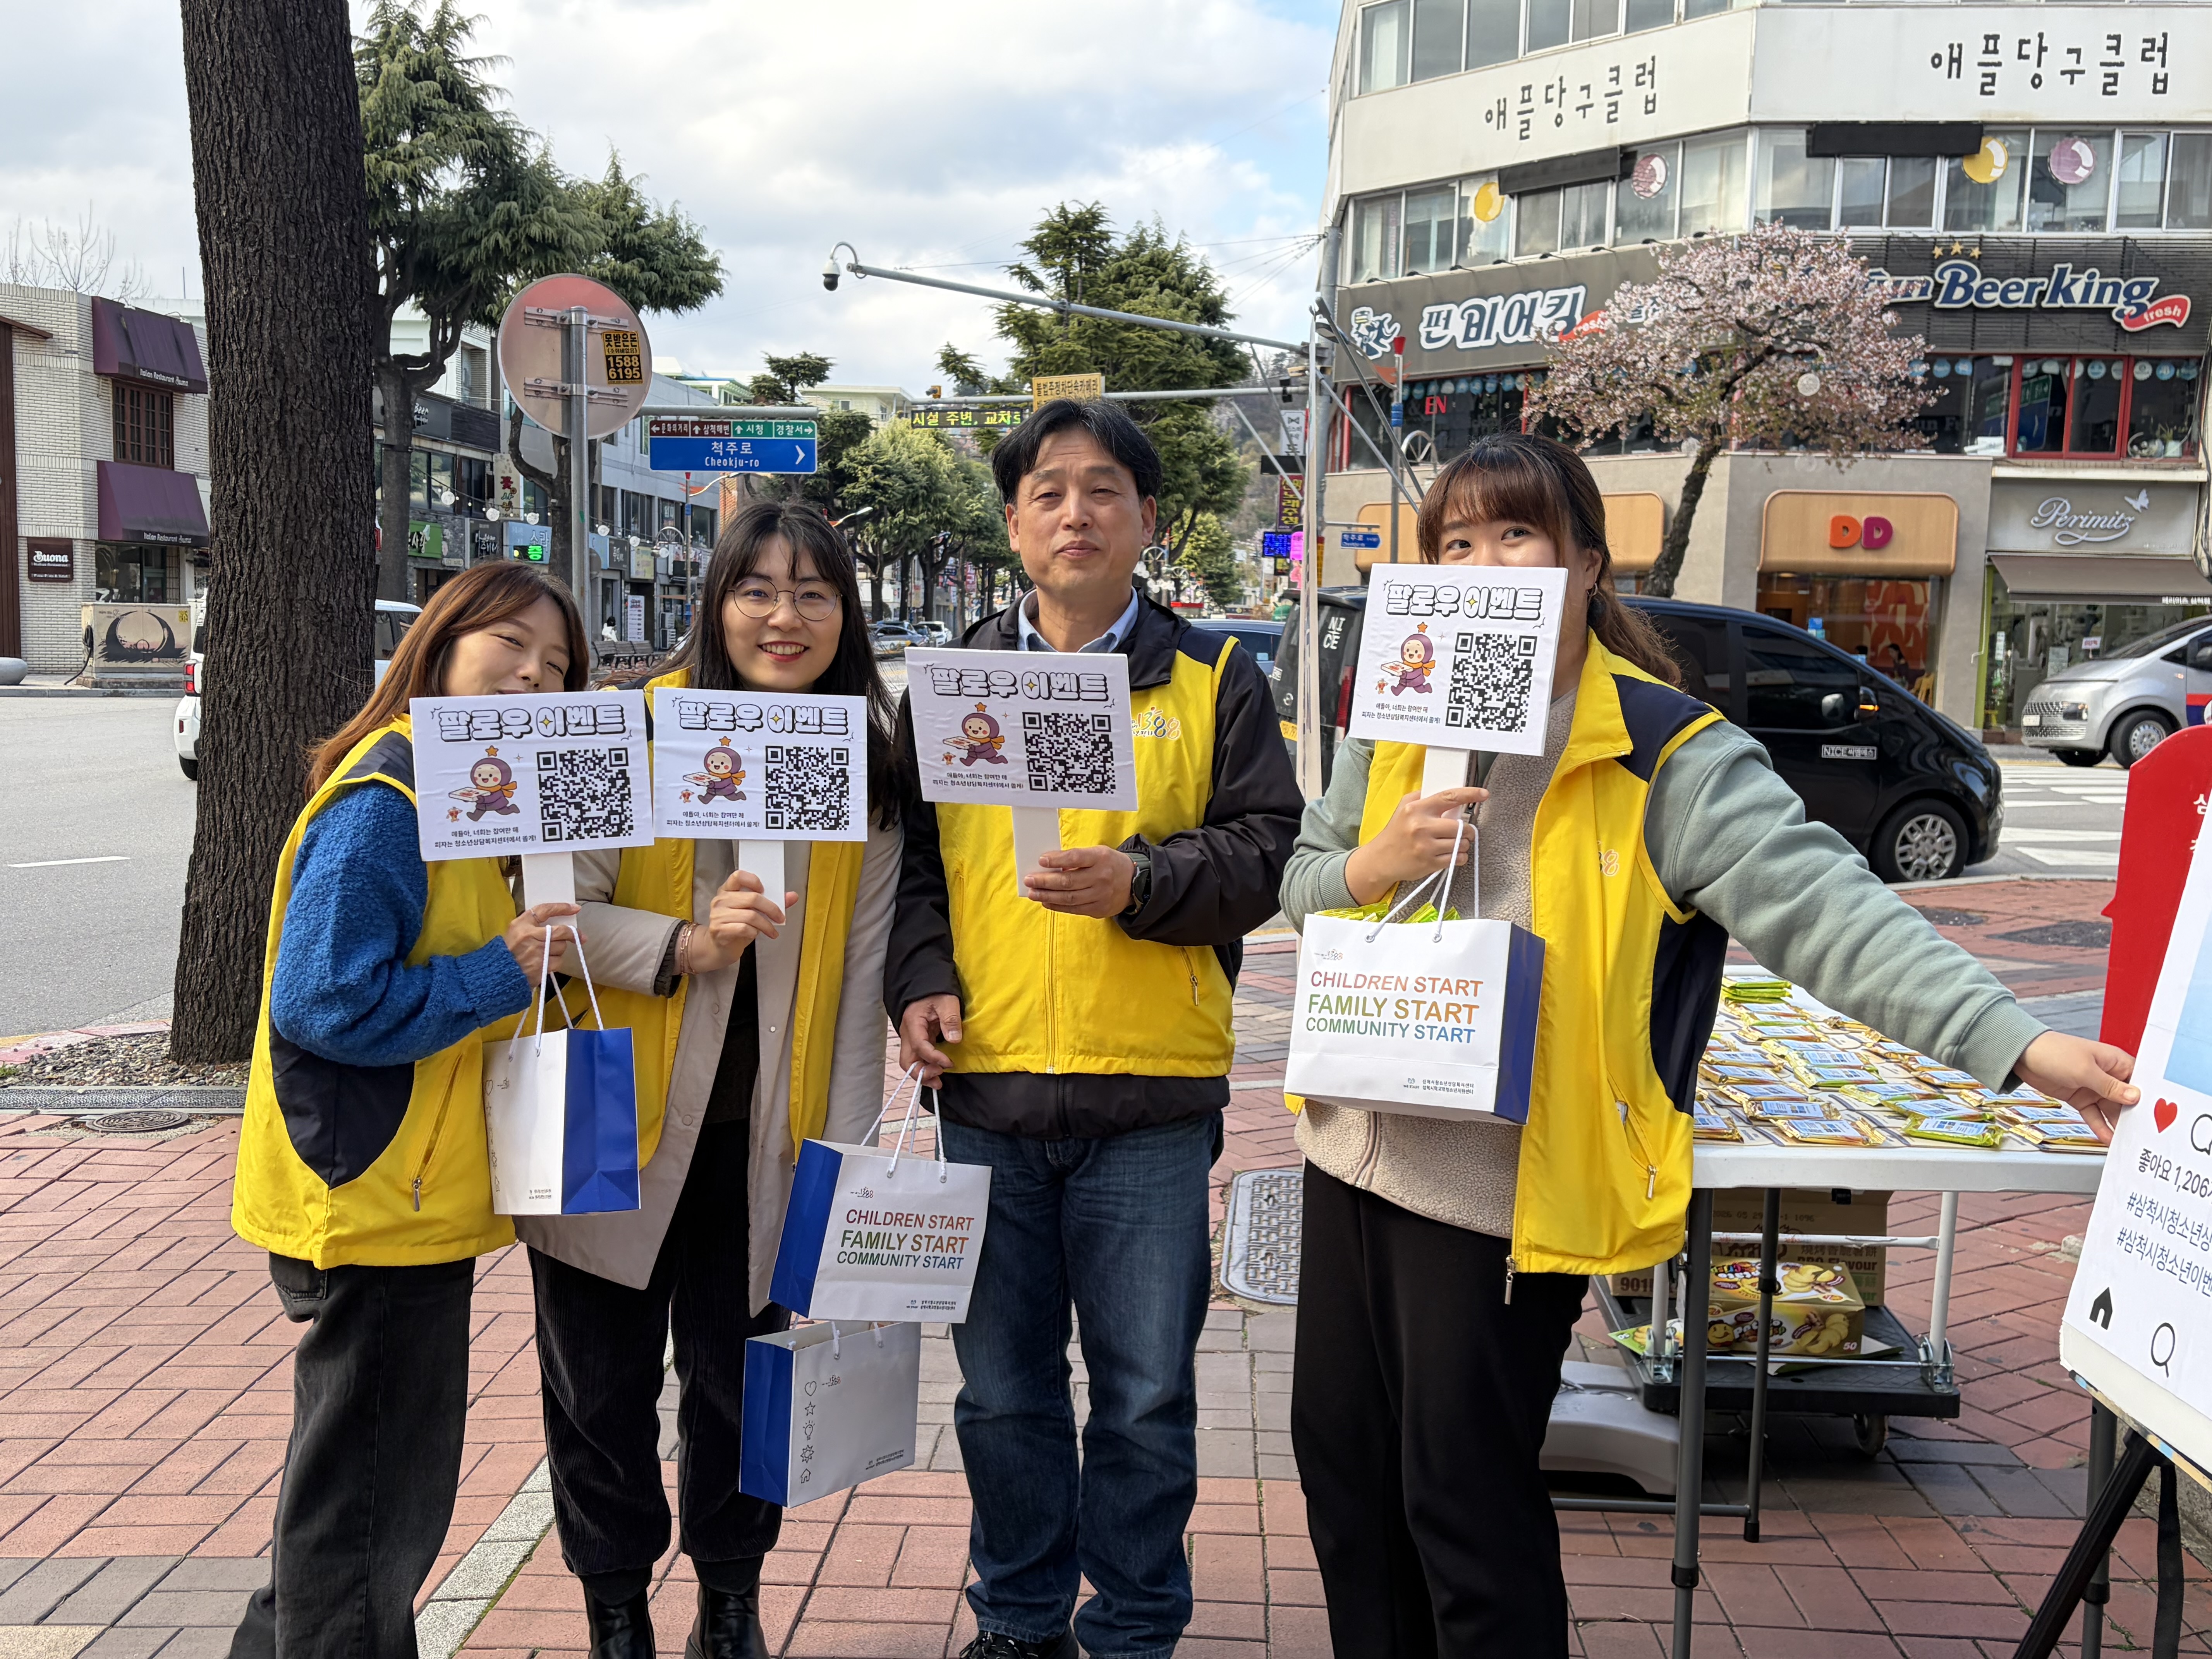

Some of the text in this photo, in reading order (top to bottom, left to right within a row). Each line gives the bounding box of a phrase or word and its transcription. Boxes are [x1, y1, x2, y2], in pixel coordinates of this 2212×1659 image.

[1931, 32, 2169, 96] 애플당구클럽
[1485, 55, 1656, 140] 애플당구클럽
[1421, 285, 1585, 349] 펀비어킹
[2144, 305, 2182, 323] fresh
[608, 356, 639, 367] 1588
[609, 368, 640, 379] 6195
[662, 423, 688, 433] 문화의거리
[703, 424, 730, 435] 삼척해변
[746, 424, 764, 435] 시청
[912, 411, 939, 426] 시설
[776, 425, 803, 436] 경찰서
[711, 441, 752, 455] 척주로
[705, 457, 759, 468] Cheokju-ro
[1829, 515, 1893, 549] DD
[33, 551, 69, 563] Buona
[1386, 584, 1543, 620] 팔로우 이벤트
[931, 668, 1109, 701] 팔로우 이벤트
[438, 704, 627, 742] 팔로우 이벤트
[679, 701, 848, 735] 팔로우 이벤트
[1137, 711, 1180, 740] 1388
[1310, 971, 1484, 997] CHILDREN START
[1308, 994, 1480, 1024] FAMILY START
[1306, 1017, 1475, 1044] COMMUNITY START
[2138, 1148, 2172, 1181] 좋아요
[846, 1209, 975, 1231] CHILDREN START
[1752, 1211, 1763, 1219] 29
[840, 1230, 969, 1254] FAMILY START
[837, 1251, 964, 1269] COMMUNITY START
[1843, 1342, 1858, 1350] 50
